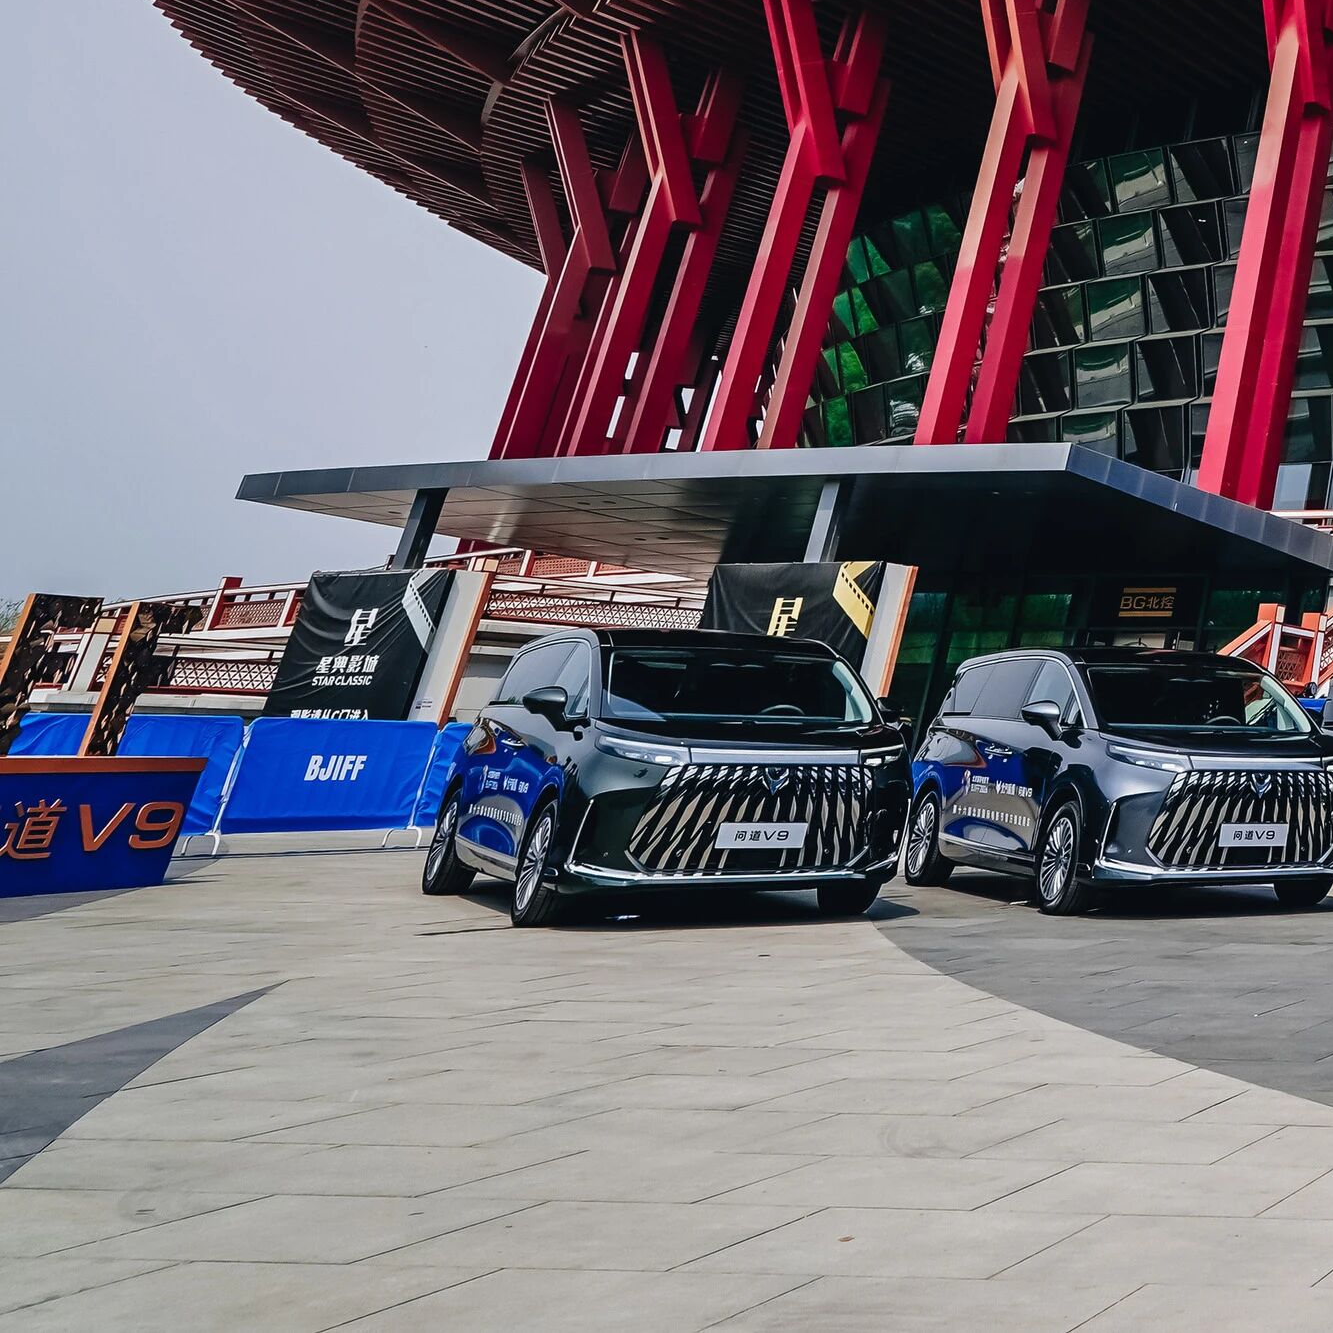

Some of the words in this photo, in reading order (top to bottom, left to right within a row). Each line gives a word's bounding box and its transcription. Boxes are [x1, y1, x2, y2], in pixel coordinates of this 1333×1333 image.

[316, 655, 379, 673] 星典影城
[312, 676, 334, 686] STAR
[335, 675, 372, 685] CLASSIC
[304, 755, 367, 781] BJIFF
[735, 831, 789, 841] 问道V9
[1233, 831, 1275, 840] 问道V9
